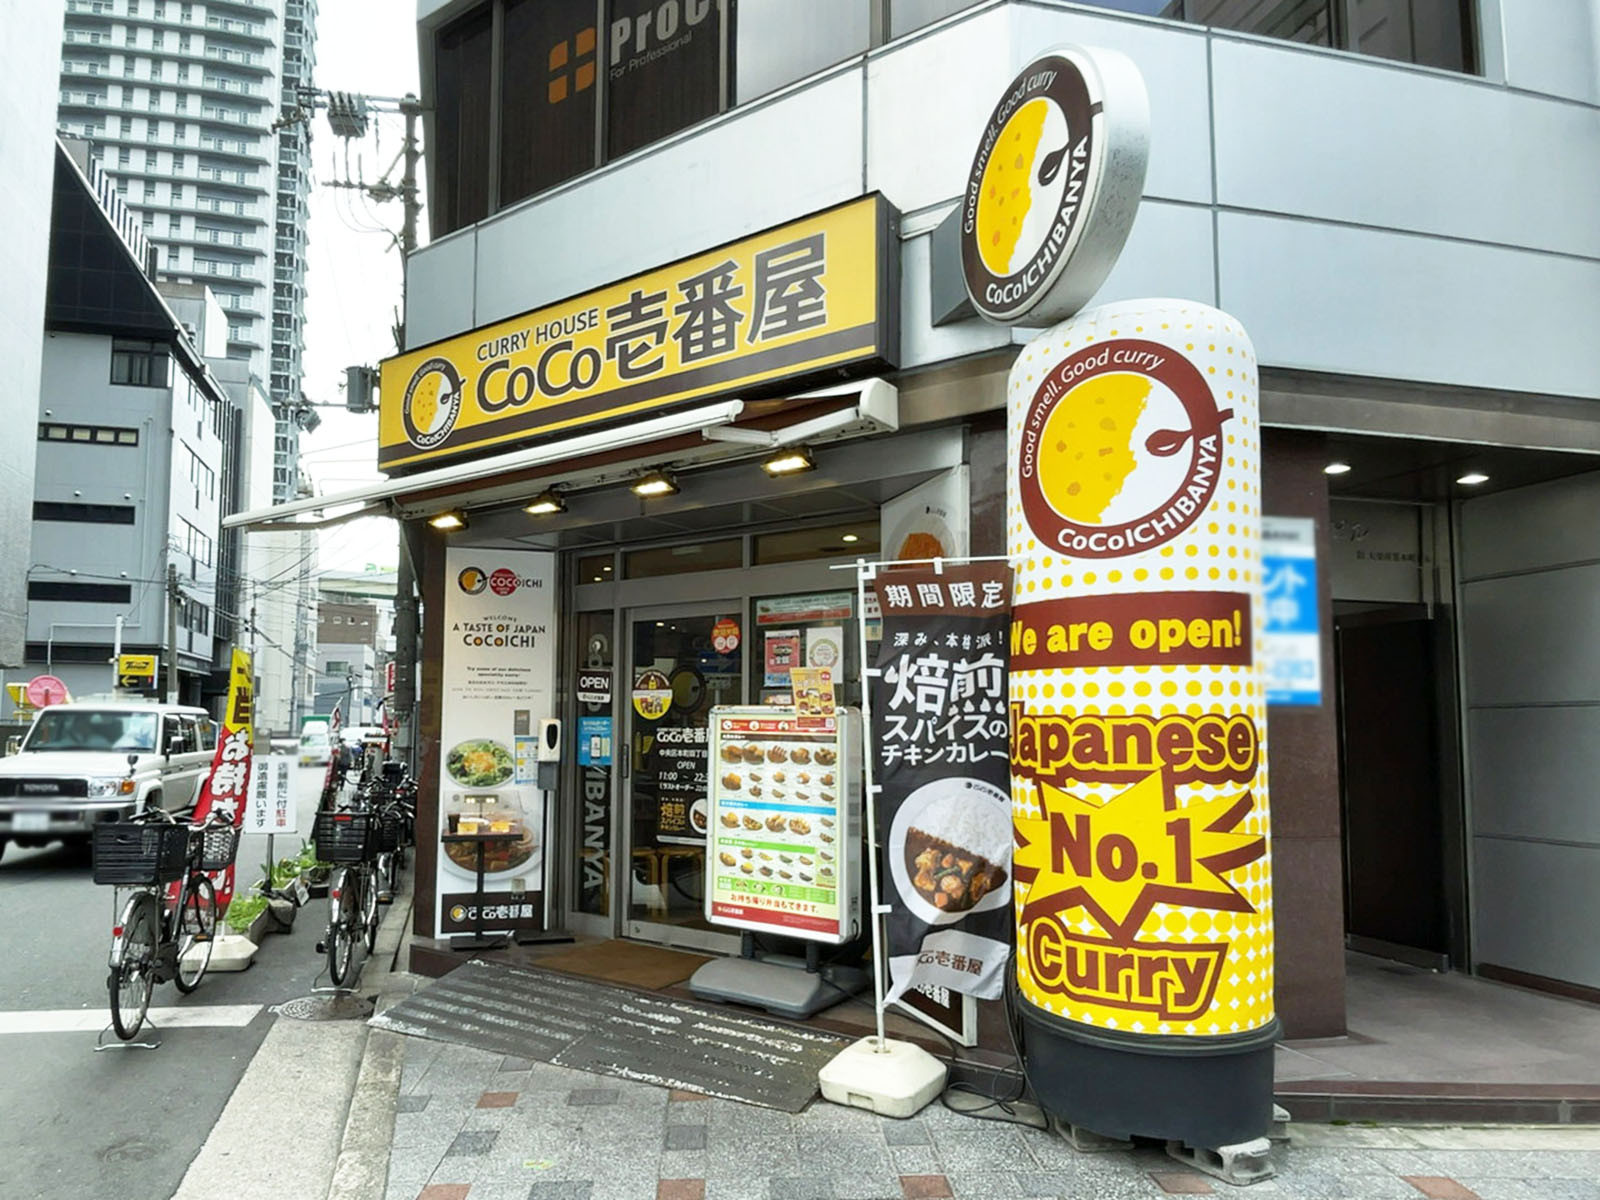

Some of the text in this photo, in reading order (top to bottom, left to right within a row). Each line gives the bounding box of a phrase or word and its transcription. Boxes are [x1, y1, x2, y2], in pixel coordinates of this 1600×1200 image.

[610, 30, 692, 80] For Professional
[963, 70, 1058, 234] Good smell. Good curry
[985, 135, 1089, 305] CoCoICHIBANYA
[476, 232, 826, 413] CoCo壱番屋
[477, 308, 598, 361] CURRY HOUSE
[1021, 348, 1166, 478] Good smell. Good curry
[1057, 434, 1218, 552] CoCoICHIBANYA
[483, 614, 518, 623] WELCOME
[884, 580, 1004, 608] 期間限定
[453, 623, 546, 634] A TASTE OF JAPAN
[1011, 619, 1037, 656] We
[1046, 620, 1114, 653] are
[1129, 609, 1242, 654] open!
[580, 676, 609, 689] OPEN
[884, 653, 1007, 717] 焙煎
[882, 714, 1008, 744] スパイスの
[1010, 702, 1255, 773] Japanese
[658, 771, 678, 781] 11:00
[676, 760, 696, 770] OPEN
[881, 743, 1009, 767] チキンカレー
[1050, 812, 1193, 884] No.1
[1033, 922, 1212, 1008] Curry
